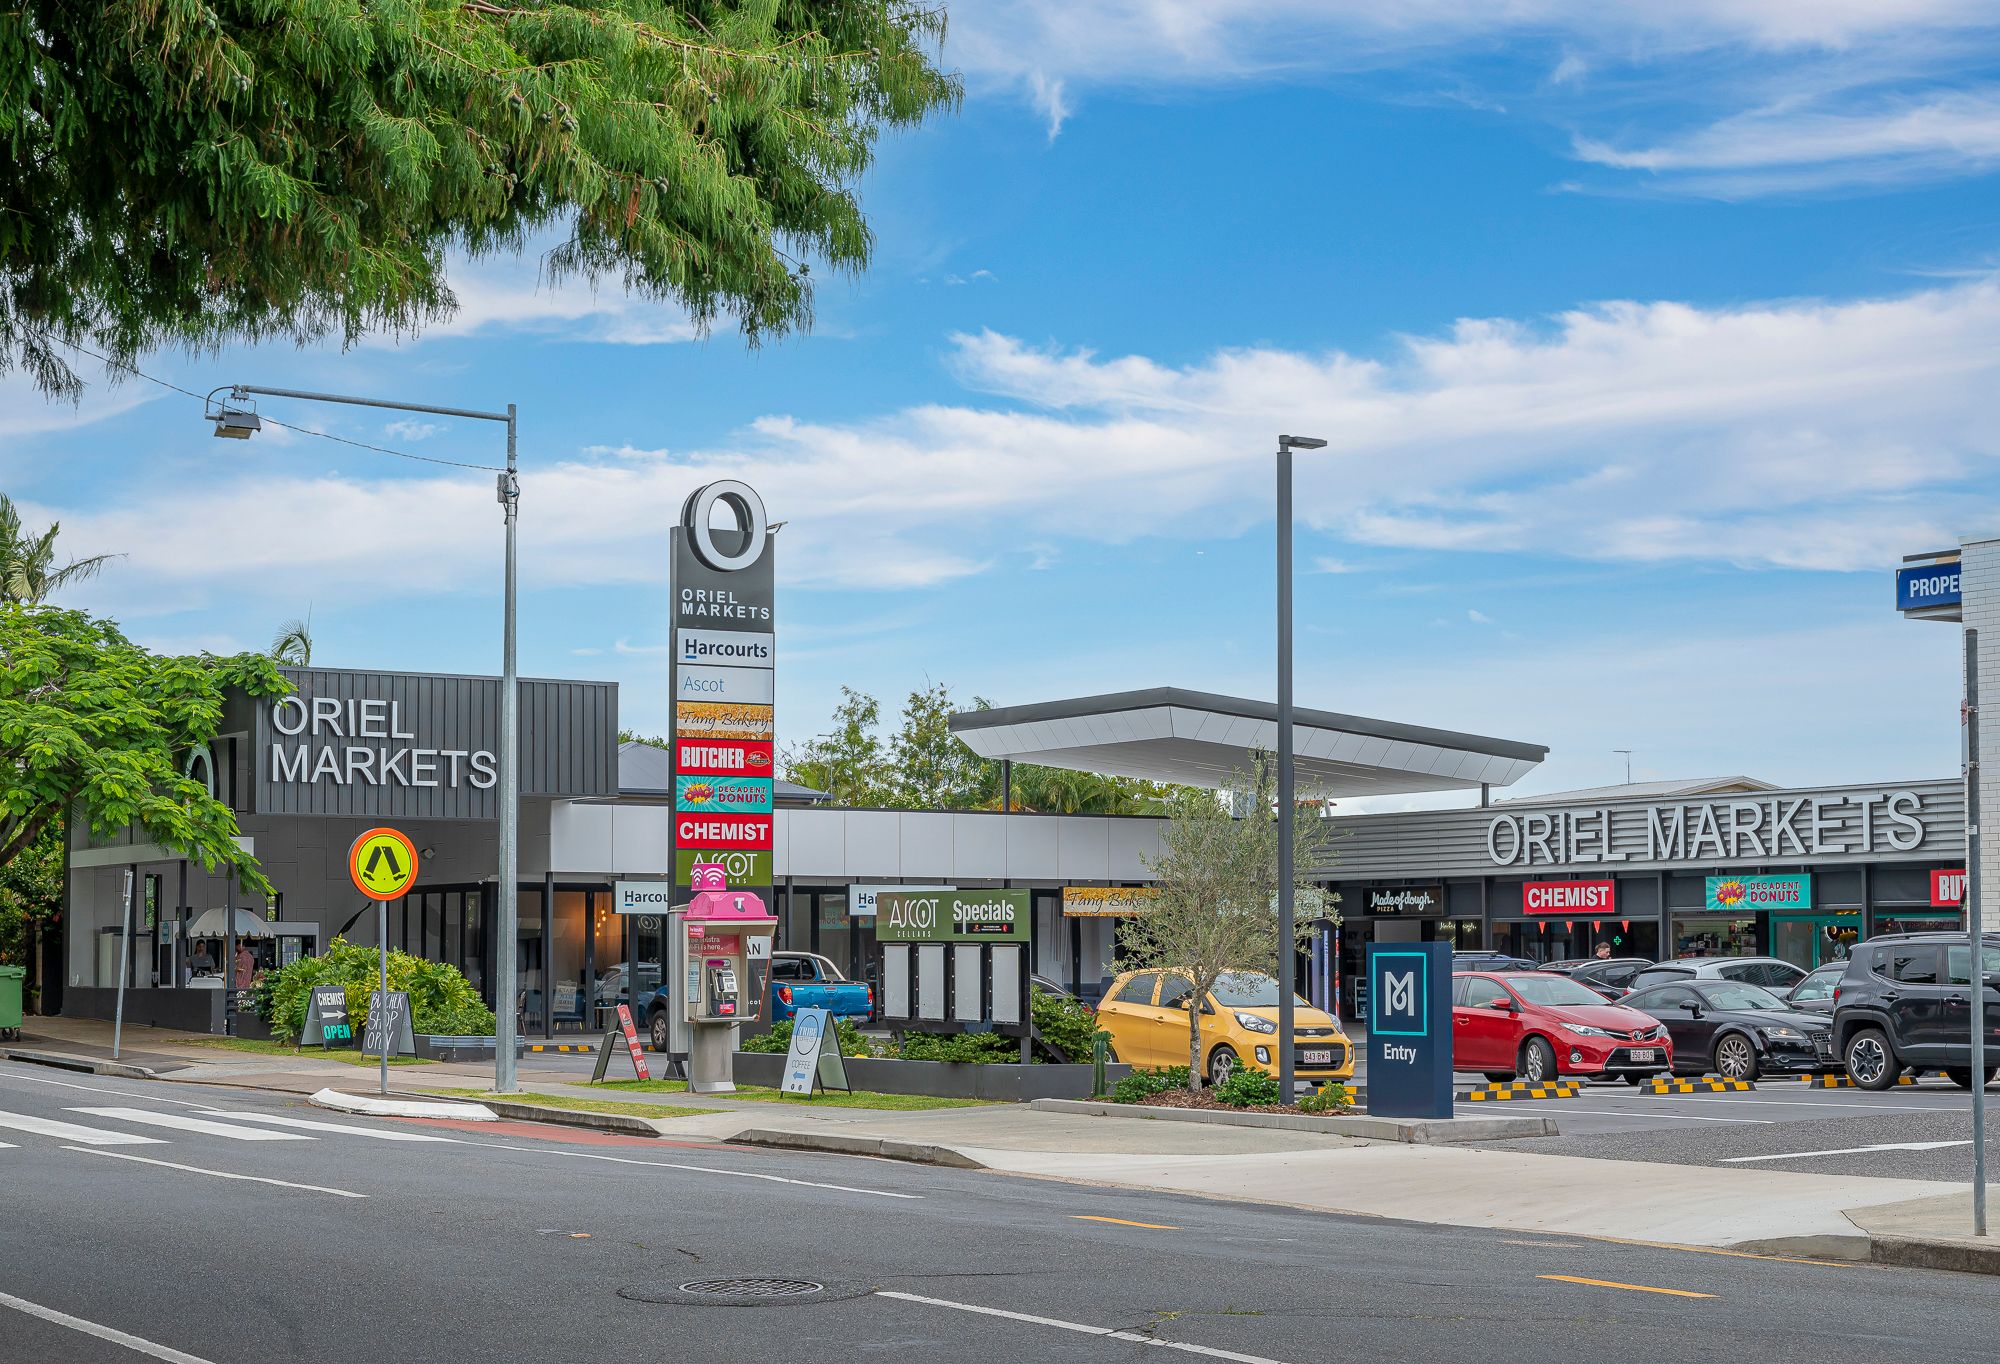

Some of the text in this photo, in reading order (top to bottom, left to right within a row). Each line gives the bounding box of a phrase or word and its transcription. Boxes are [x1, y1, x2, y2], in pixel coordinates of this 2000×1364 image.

[1909, 574, 1961, 598] PROPE
[682, 588, 738, 605] ORIEL
[682, 602, 770, 620] MARKETS
[685, 638, 768, 658] Harcourts
[683, 675, 725, 693] Ascot
[273, 696, 415, 739] ORIEL
[682, 711, 769, 734] Tang Bakery
[272, 743, 497, 789] MARKETS
[681, 746, 744, 769] BUTCHER
[684, 784, 767, 803] OMG! DECADENT
[718, 793, 766, 804] DONUTS
[679, 822, 769, 841] CHEMIST
[1487, 790, 1927, 866] ORIEL MARKETS
[1527, 886, 1610, 908] CHEMIST
[1716, 881, 1799, 904] OMG! DECADENT
[1750, 890, 1799, 903] DONUTS
[1068, 892, 1104, 914] Tang
[889, 899, 1015, 934] ASCOT Specials
[897, 930, 931, 938] CELLARS
[318, 992, 345, 1006] CHEMIST
[323, 1024, 351, 1040] OPEN
[1384, 1043, 1416, 1064] Entry
[791, 1059, 811, 1070] COFFEE
